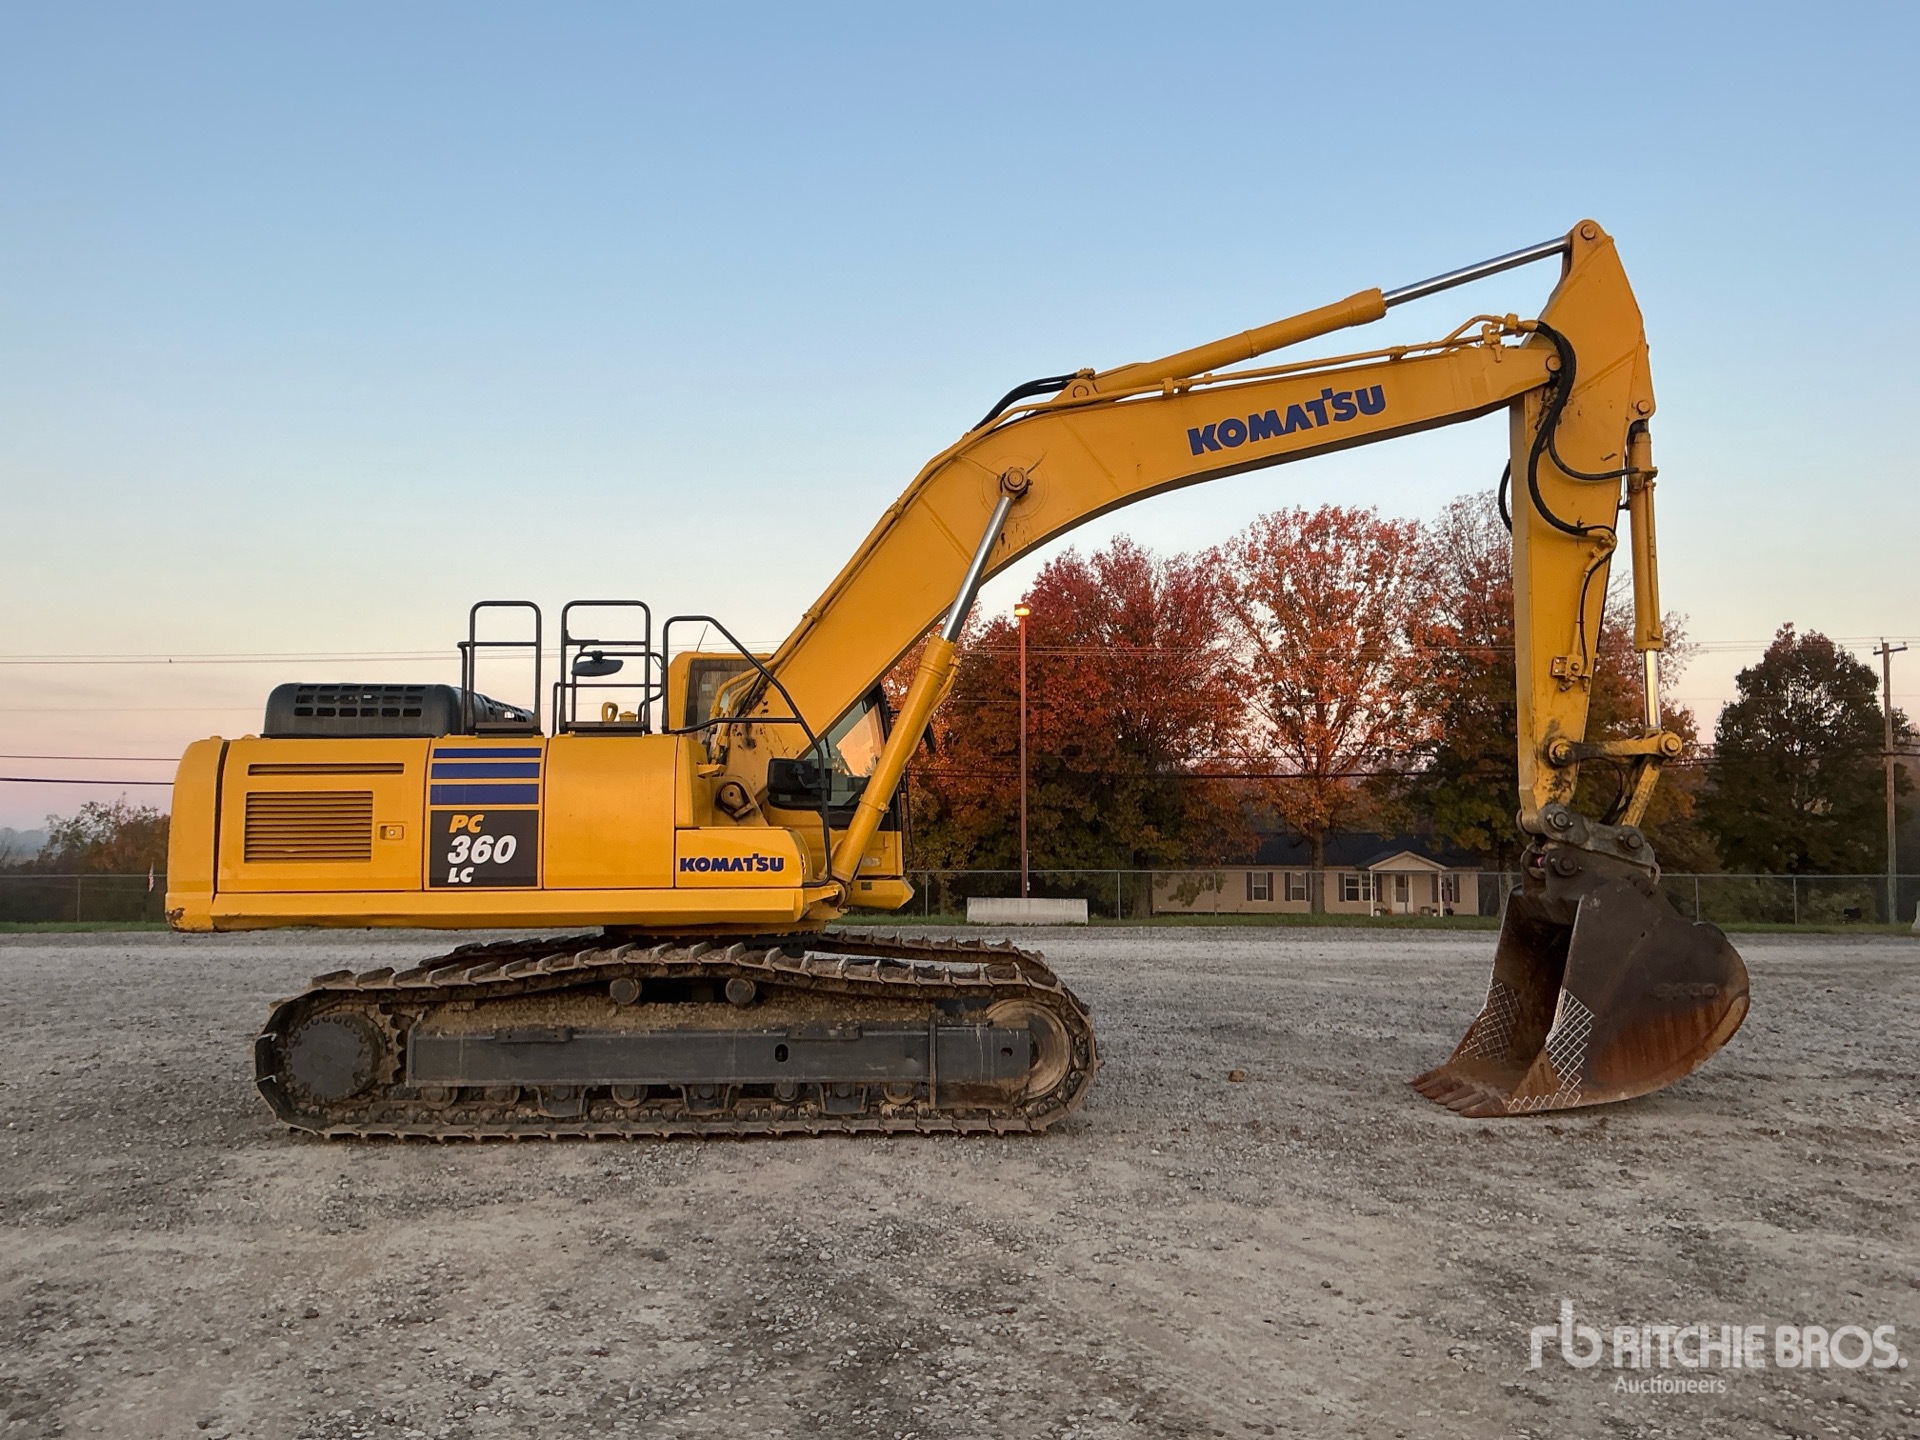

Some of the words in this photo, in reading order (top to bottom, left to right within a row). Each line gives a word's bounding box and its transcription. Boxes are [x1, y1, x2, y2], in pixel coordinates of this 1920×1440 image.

[1187, 385, 1386, 456] KOMATSU
[448, 814, 485, 833] PC
[447, 834, 517, 864] 360
[679, 853, 784, 872] KOMATSU
[447, 867, 474, 883] LC
